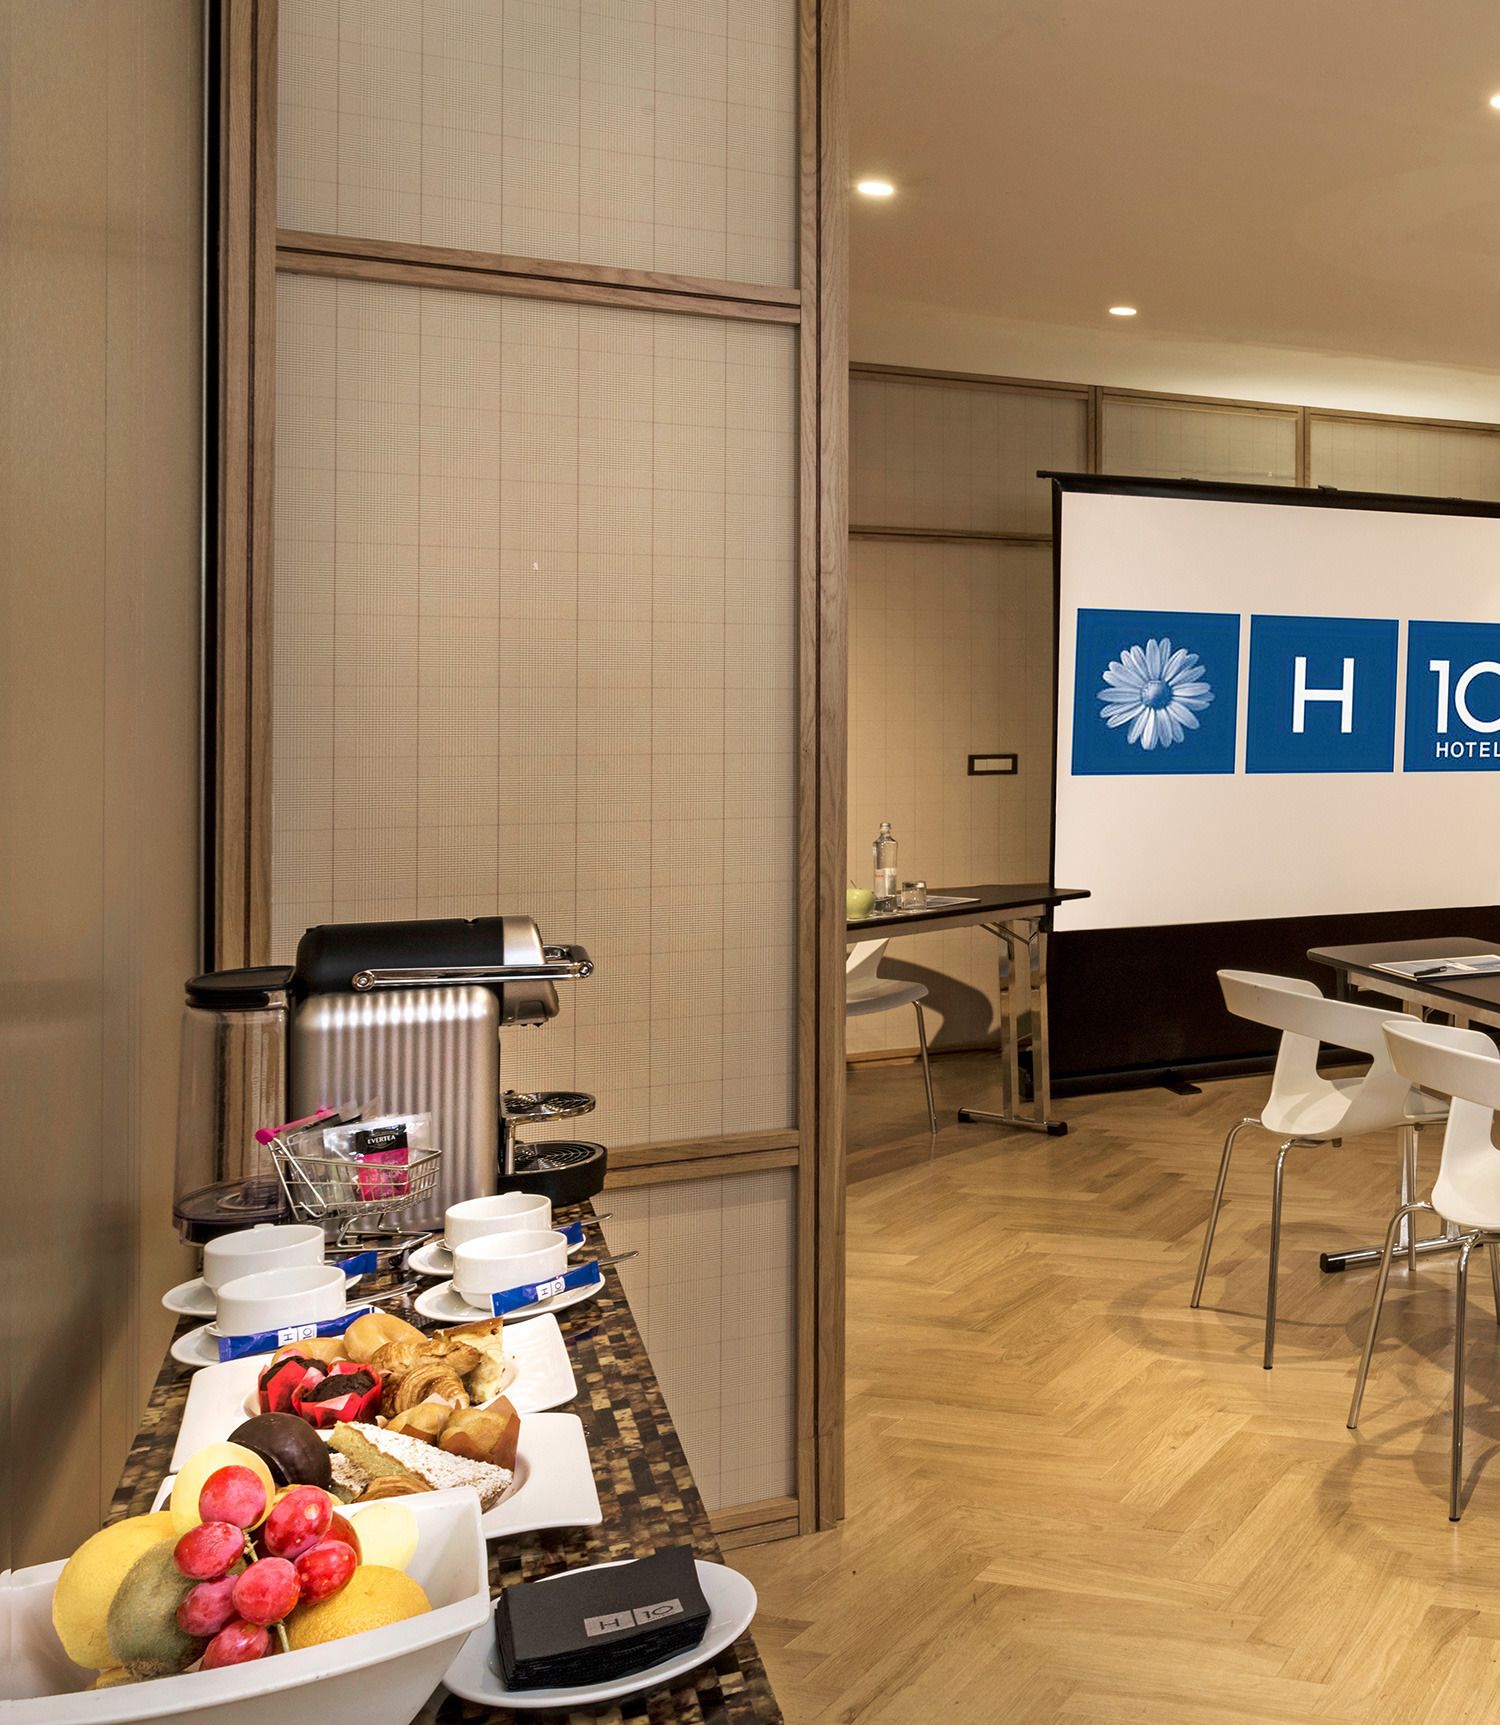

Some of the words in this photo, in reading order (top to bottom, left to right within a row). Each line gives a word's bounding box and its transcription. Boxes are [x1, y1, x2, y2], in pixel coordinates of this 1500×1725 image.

[1292, 656, 1354, 733] H
[367, 1134, 396, 1145] EVERTEA
[600, 1618, 620, 1630] H
[643, 1605, 674, 1619] 10
